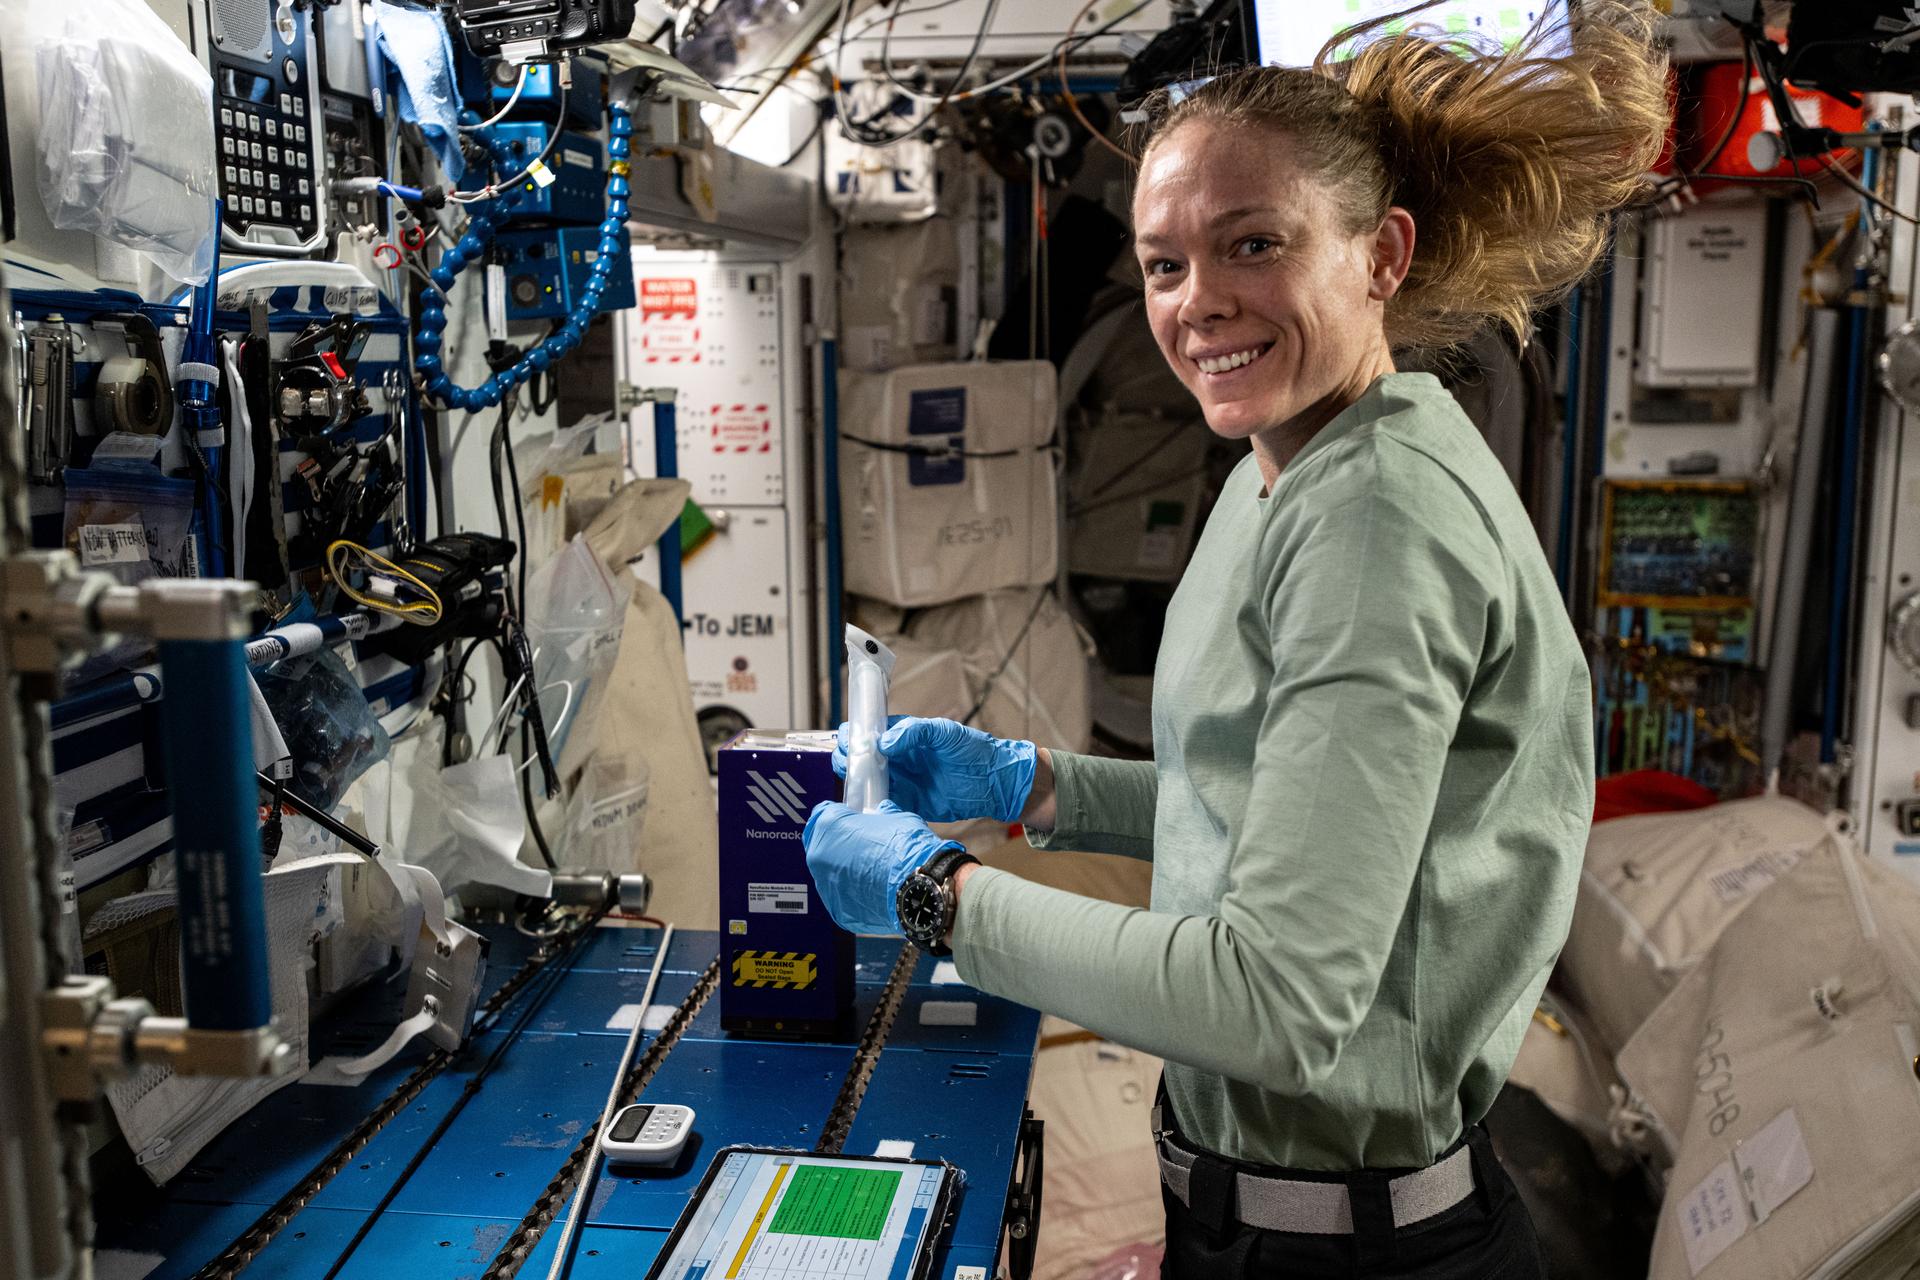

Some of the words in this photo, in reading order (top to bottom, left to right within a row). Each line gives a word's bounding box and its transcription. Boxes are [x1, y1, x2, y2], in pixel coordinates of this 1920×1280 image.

[693, 613, 720, 637] To
[726, 613, 774, 637] JEM
[746, 828, 803, 840] Nanorack
[754, 960, 794, 968] WARNING
